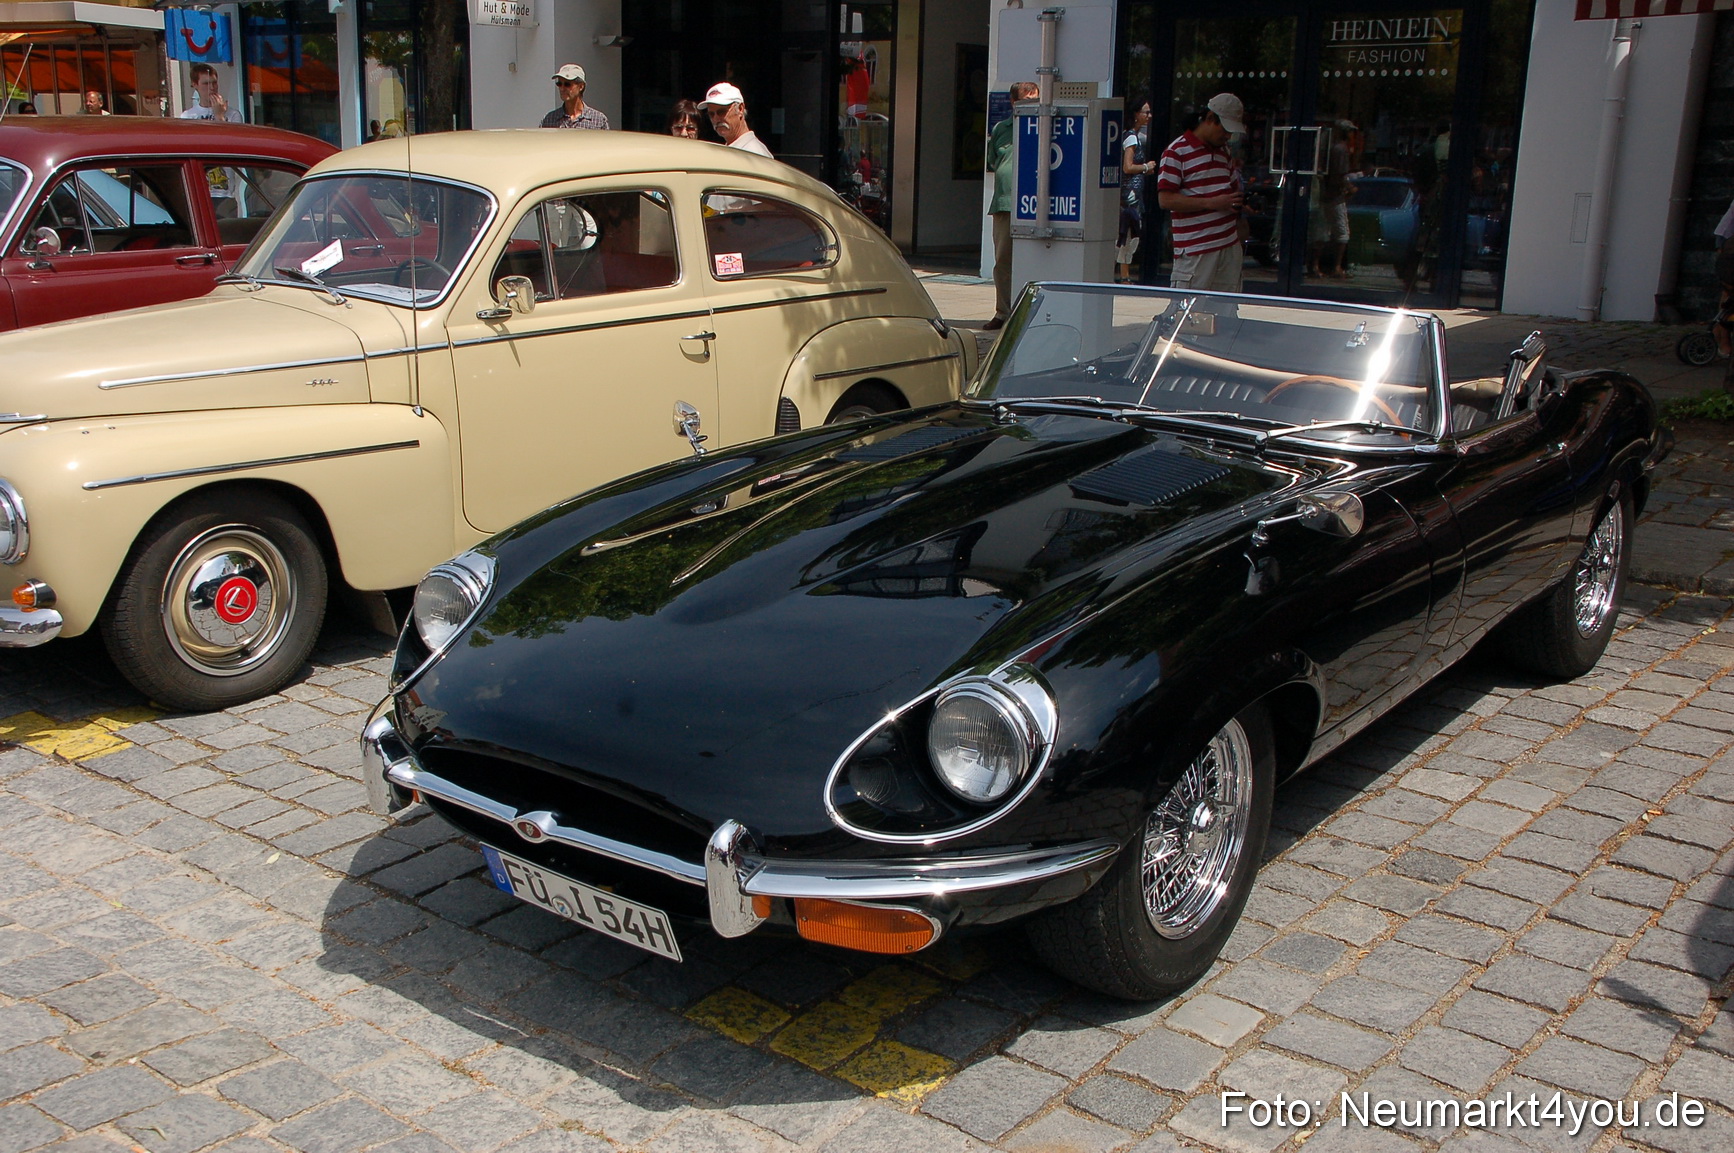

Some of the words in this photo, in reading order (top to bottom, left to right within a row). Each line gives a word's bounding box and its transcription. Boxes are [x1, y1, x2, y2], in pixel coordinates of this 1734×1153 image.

[483, 2, 497, 14] Hut
[500, 2, 507, 14] &
[509, 4, 530, 16] Mode
[490, 15, 521, 26] Hülsmann
[1330, 16, 1453, 41] HEINLEIN
[1347, 48, 1426, 63] FASHION
[1027, 117, 1075, 136] HER
[1106, 120, 1119, 156] P
[1020, 195, 1077, 216] SCEINE
[496, 872, 506, 884] D
[502, 858, 553, 907] FÜ
[593, 895, 673, 954] 54H
